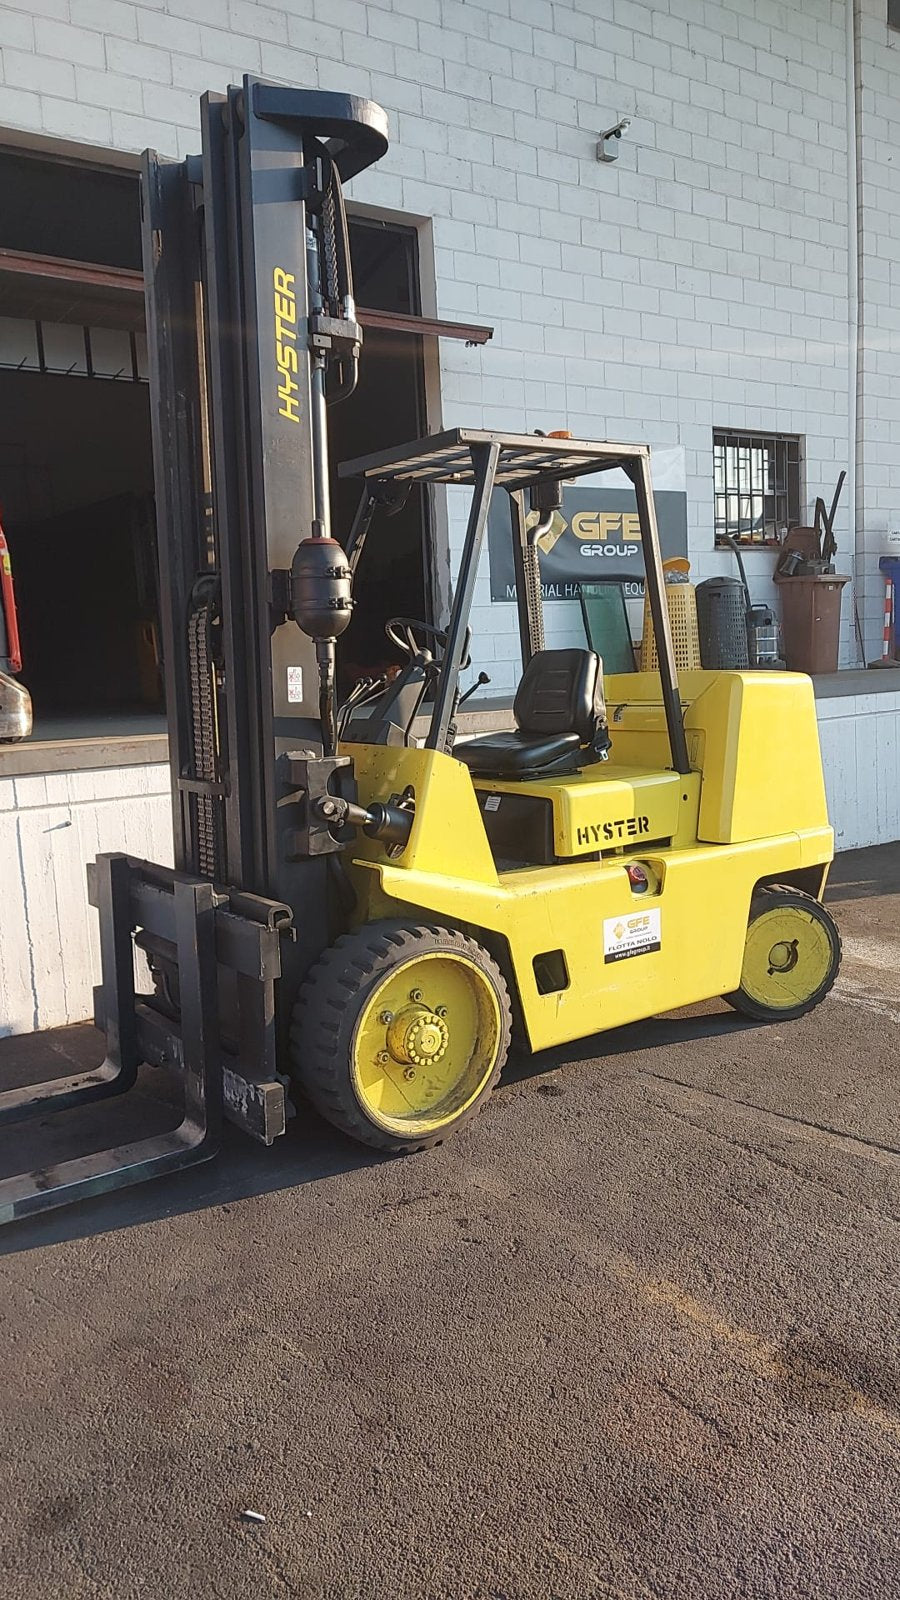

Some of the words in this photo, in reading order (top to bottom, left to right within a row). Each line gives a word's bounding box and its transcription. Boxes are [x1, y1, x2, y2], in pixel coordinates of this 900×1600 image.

[273, 266, 301, 423] HYSTER
[571, 511, 642, 541] GFE
[580, 544, 638, 557] GROUP
[506, 583, 563, 597] MRIAL
[577, 816, 649, 845] HYSTER
[627, 915, 650, 929] GFE
[608, 941, 636, 952] FLOTTA
[636, 935, 658, 945] NOLO
